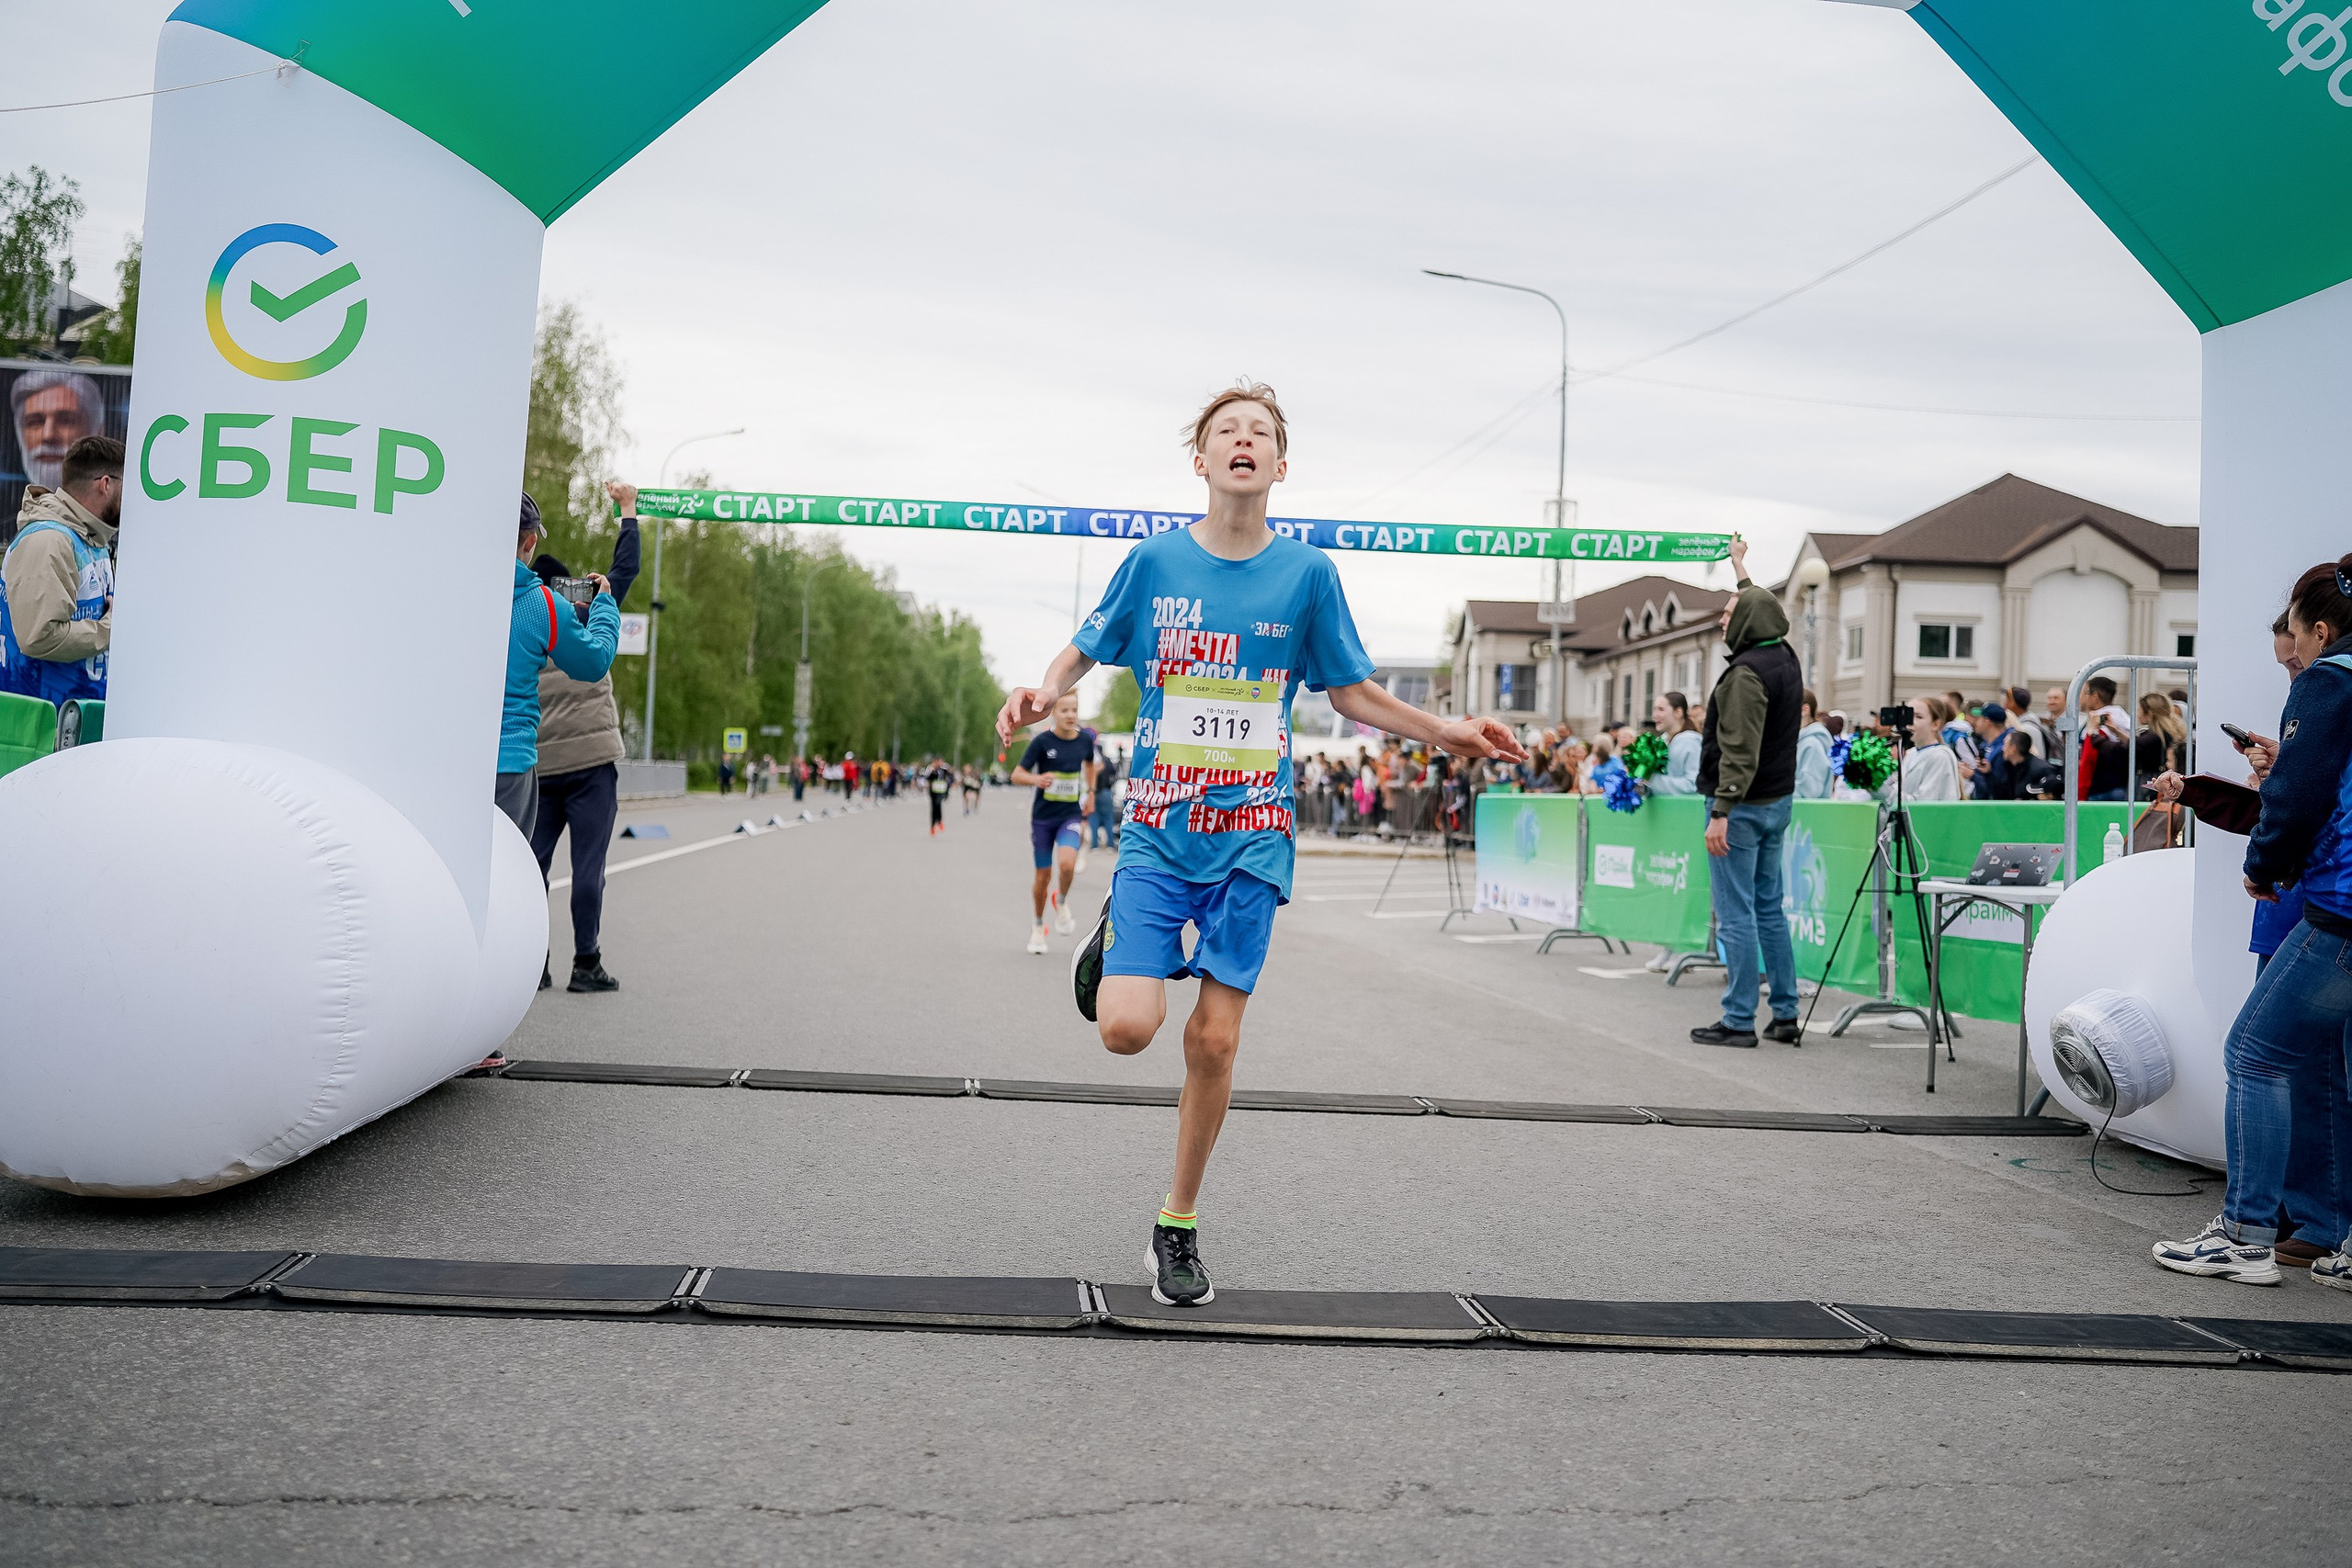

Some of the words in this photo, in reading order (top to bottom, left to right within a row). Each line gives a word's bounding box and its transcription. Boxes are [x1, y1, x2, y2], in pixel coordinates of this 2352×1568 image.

[140, 412, 446, 515] СБЕР
[713, 493, 817, 521] СТАРТ
[837, 499, 943, 526] СТАРТ
[963, 504, 1068, 534] СТАРТ
[1335, 524, 1435, 552] СТАРТ
[1454, 528, 1552, 556] СТАРТ
[1570, 533, 1664, 559] СТАРТ
[1670, 547, 1716, 558] марафон
[1152, 596, 1204, 629] 2024
[1157, 628, 1240, 665] #МЕЧТА
[1192, 715, 1250, 740] 3119
